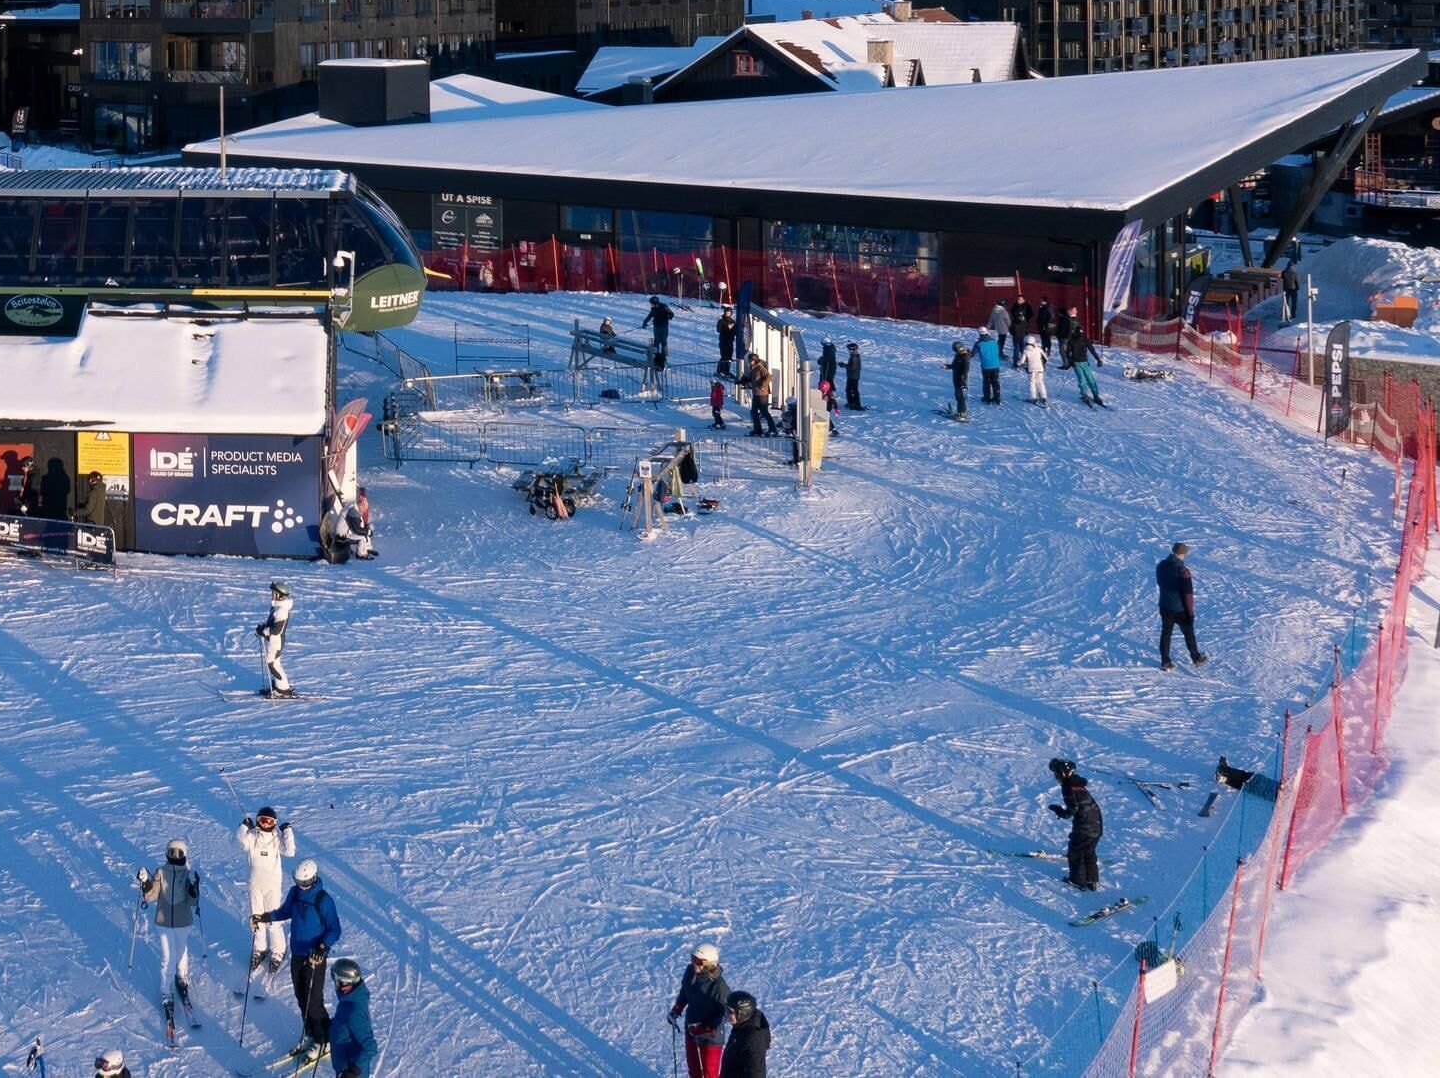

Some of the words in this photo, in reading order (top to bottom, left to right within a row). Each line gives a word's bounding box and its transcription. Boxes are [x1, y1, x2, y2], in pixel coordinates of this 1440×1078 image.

[441, 193, 454, 202] UT
[466, 194, 493, 205] SPISE
[370, 289, 420, 309] LEITNER
[1183, 290, 1202, 324] EPSI
[1331, 343, 1343, 398] PEPSI
[150, 446, 194, 470] IDÉ
[211, 450, 264, 463] PRODUCT
[266, 452, 302, 463] MEDIA
[211, 464, 277, 476] SPECIALISTS
[151, 502, 269, 528] CRAFT
[77, 528, 107, 550] IDÉ
